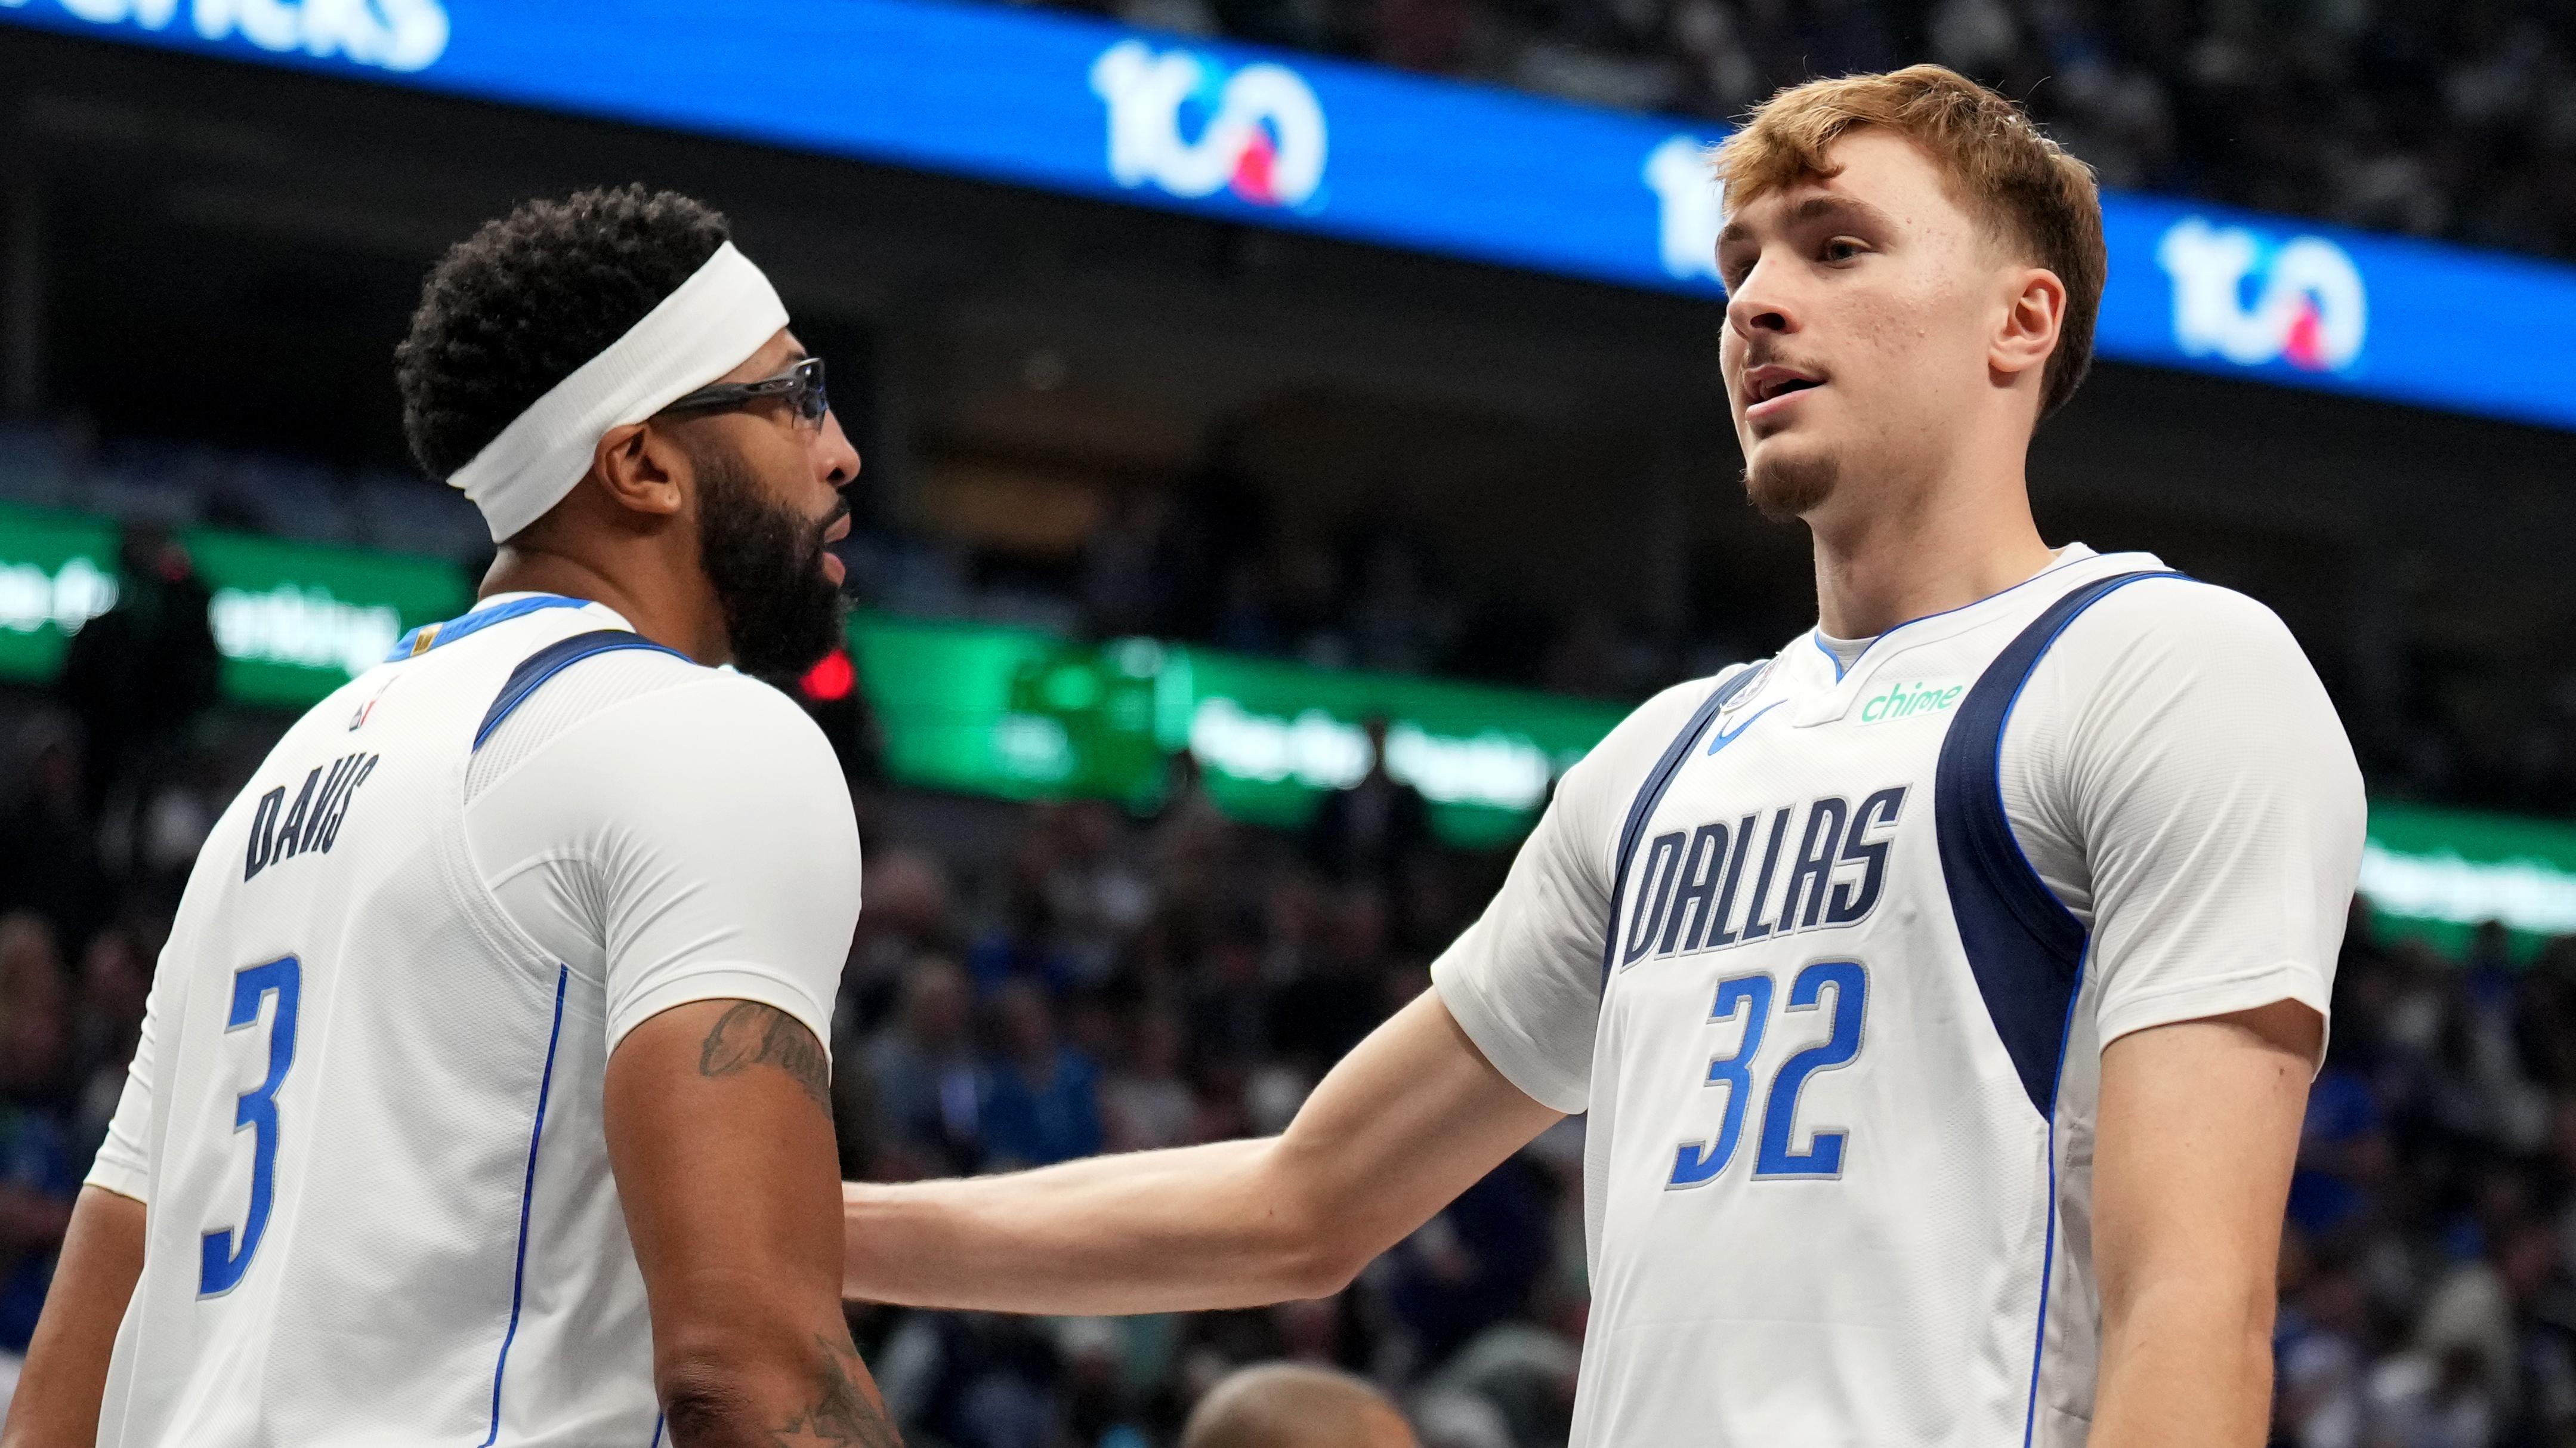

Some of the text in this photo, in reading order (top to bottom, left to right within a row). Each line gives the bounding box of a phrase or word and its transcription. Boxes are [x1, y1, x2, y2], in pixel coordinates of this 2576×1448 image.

[1861, 681, 1963, 723] chime
[243, 752, 380, 883] DAVIS
[1619, 782, 1913, 974] DALLAS
[195, 952, 303, 1302] 3
[1664, 955, 1871, 1191] 32
